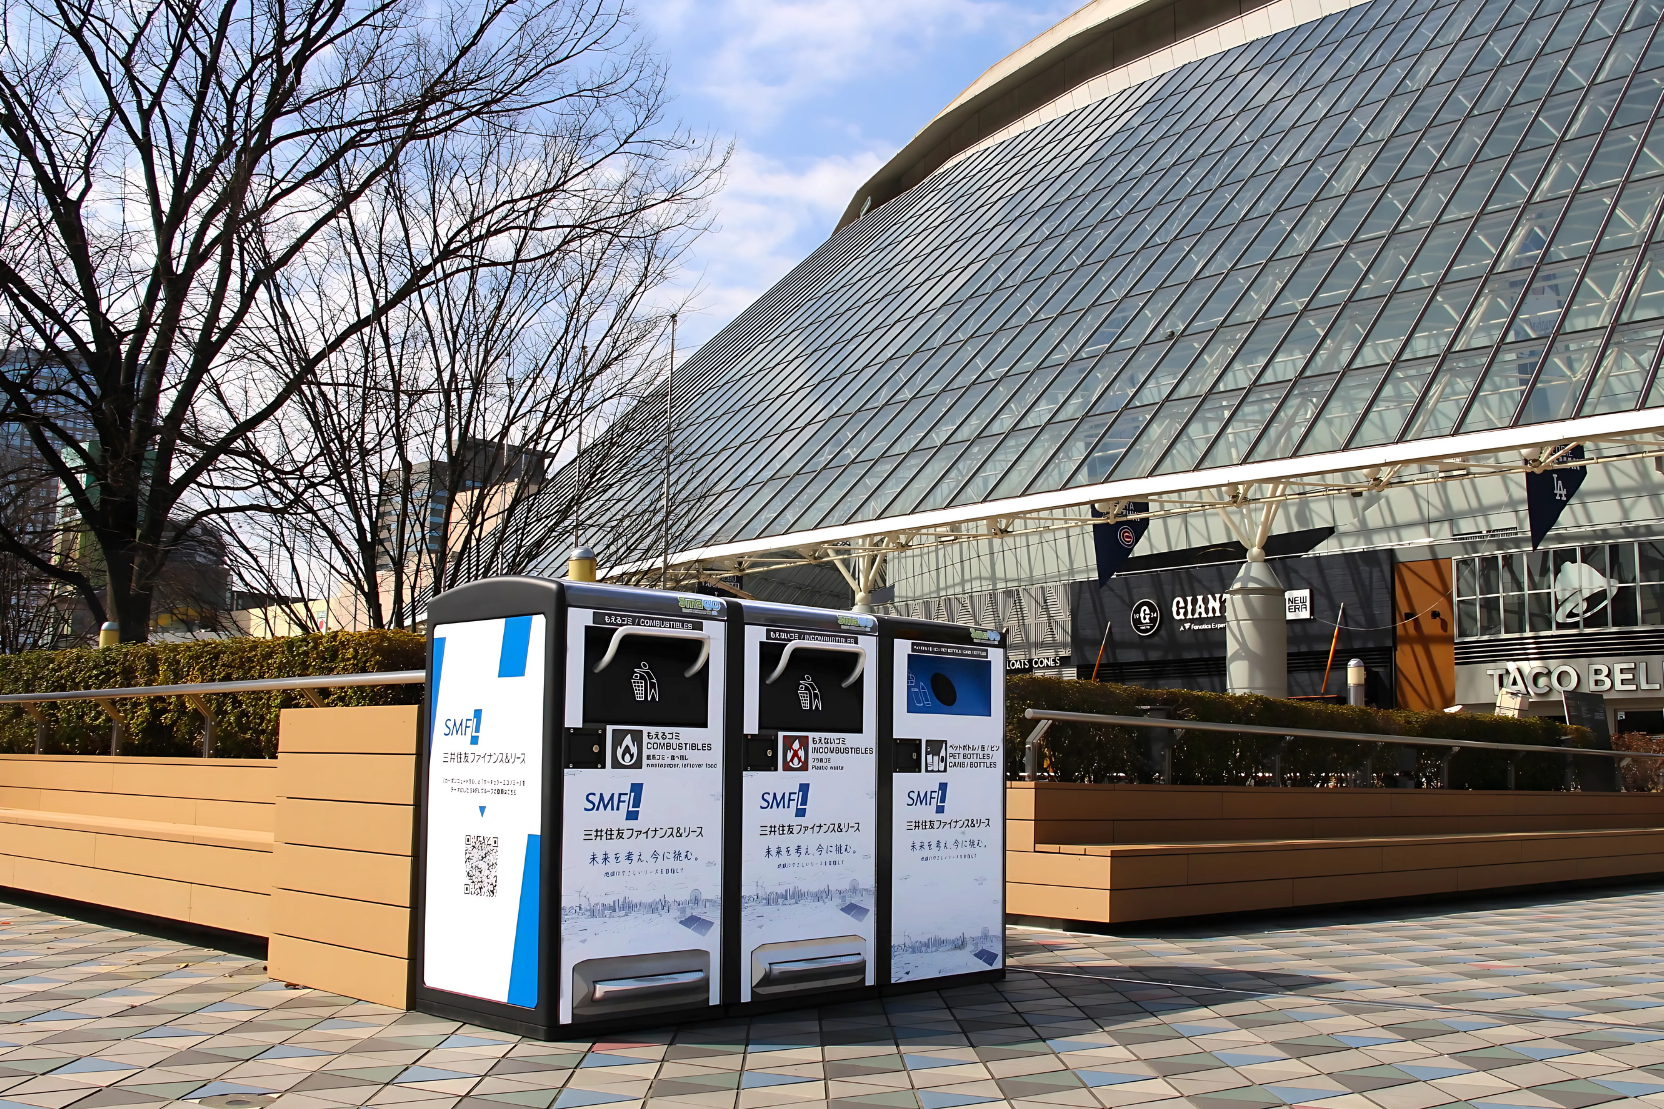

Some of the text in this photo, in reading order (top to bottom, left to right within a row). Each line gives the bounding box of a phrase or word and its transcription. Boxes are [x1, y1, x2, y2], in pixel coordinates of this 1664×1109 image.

[1287, 595, 1308, 605] NEW
[1287, 604, 1308, 613] ERA
[604, 615, 633, 625] もえるゴミ
[639, 618, 693, 630] COMBUSTIBLES
[1006, 657, 1060, 669] LOATS CONES
[1486, 661, 1664, 696] TACO BEL
[646, 731, 681, 740] もえるゴミ
[812, 737, 846, 745] もえないゴミ
[646, 742, 712, 751] COMBUSTIBLES
[811, 747, 874, 755] INCOMBUSTIBLES
[442, 751, 526, 765] 三井住友ファイナンス&リース
[948, 752, 961, 760] PET
[969, 761, 997, 769] BOTTLES
[759, 822, 861, 836] 三井住友ファイナンス&リース
[906, 818, 991, 831] 三井住友ファイナンス&リース
[582, 826, 704, 841] 三井住友ファイナンス&リース
